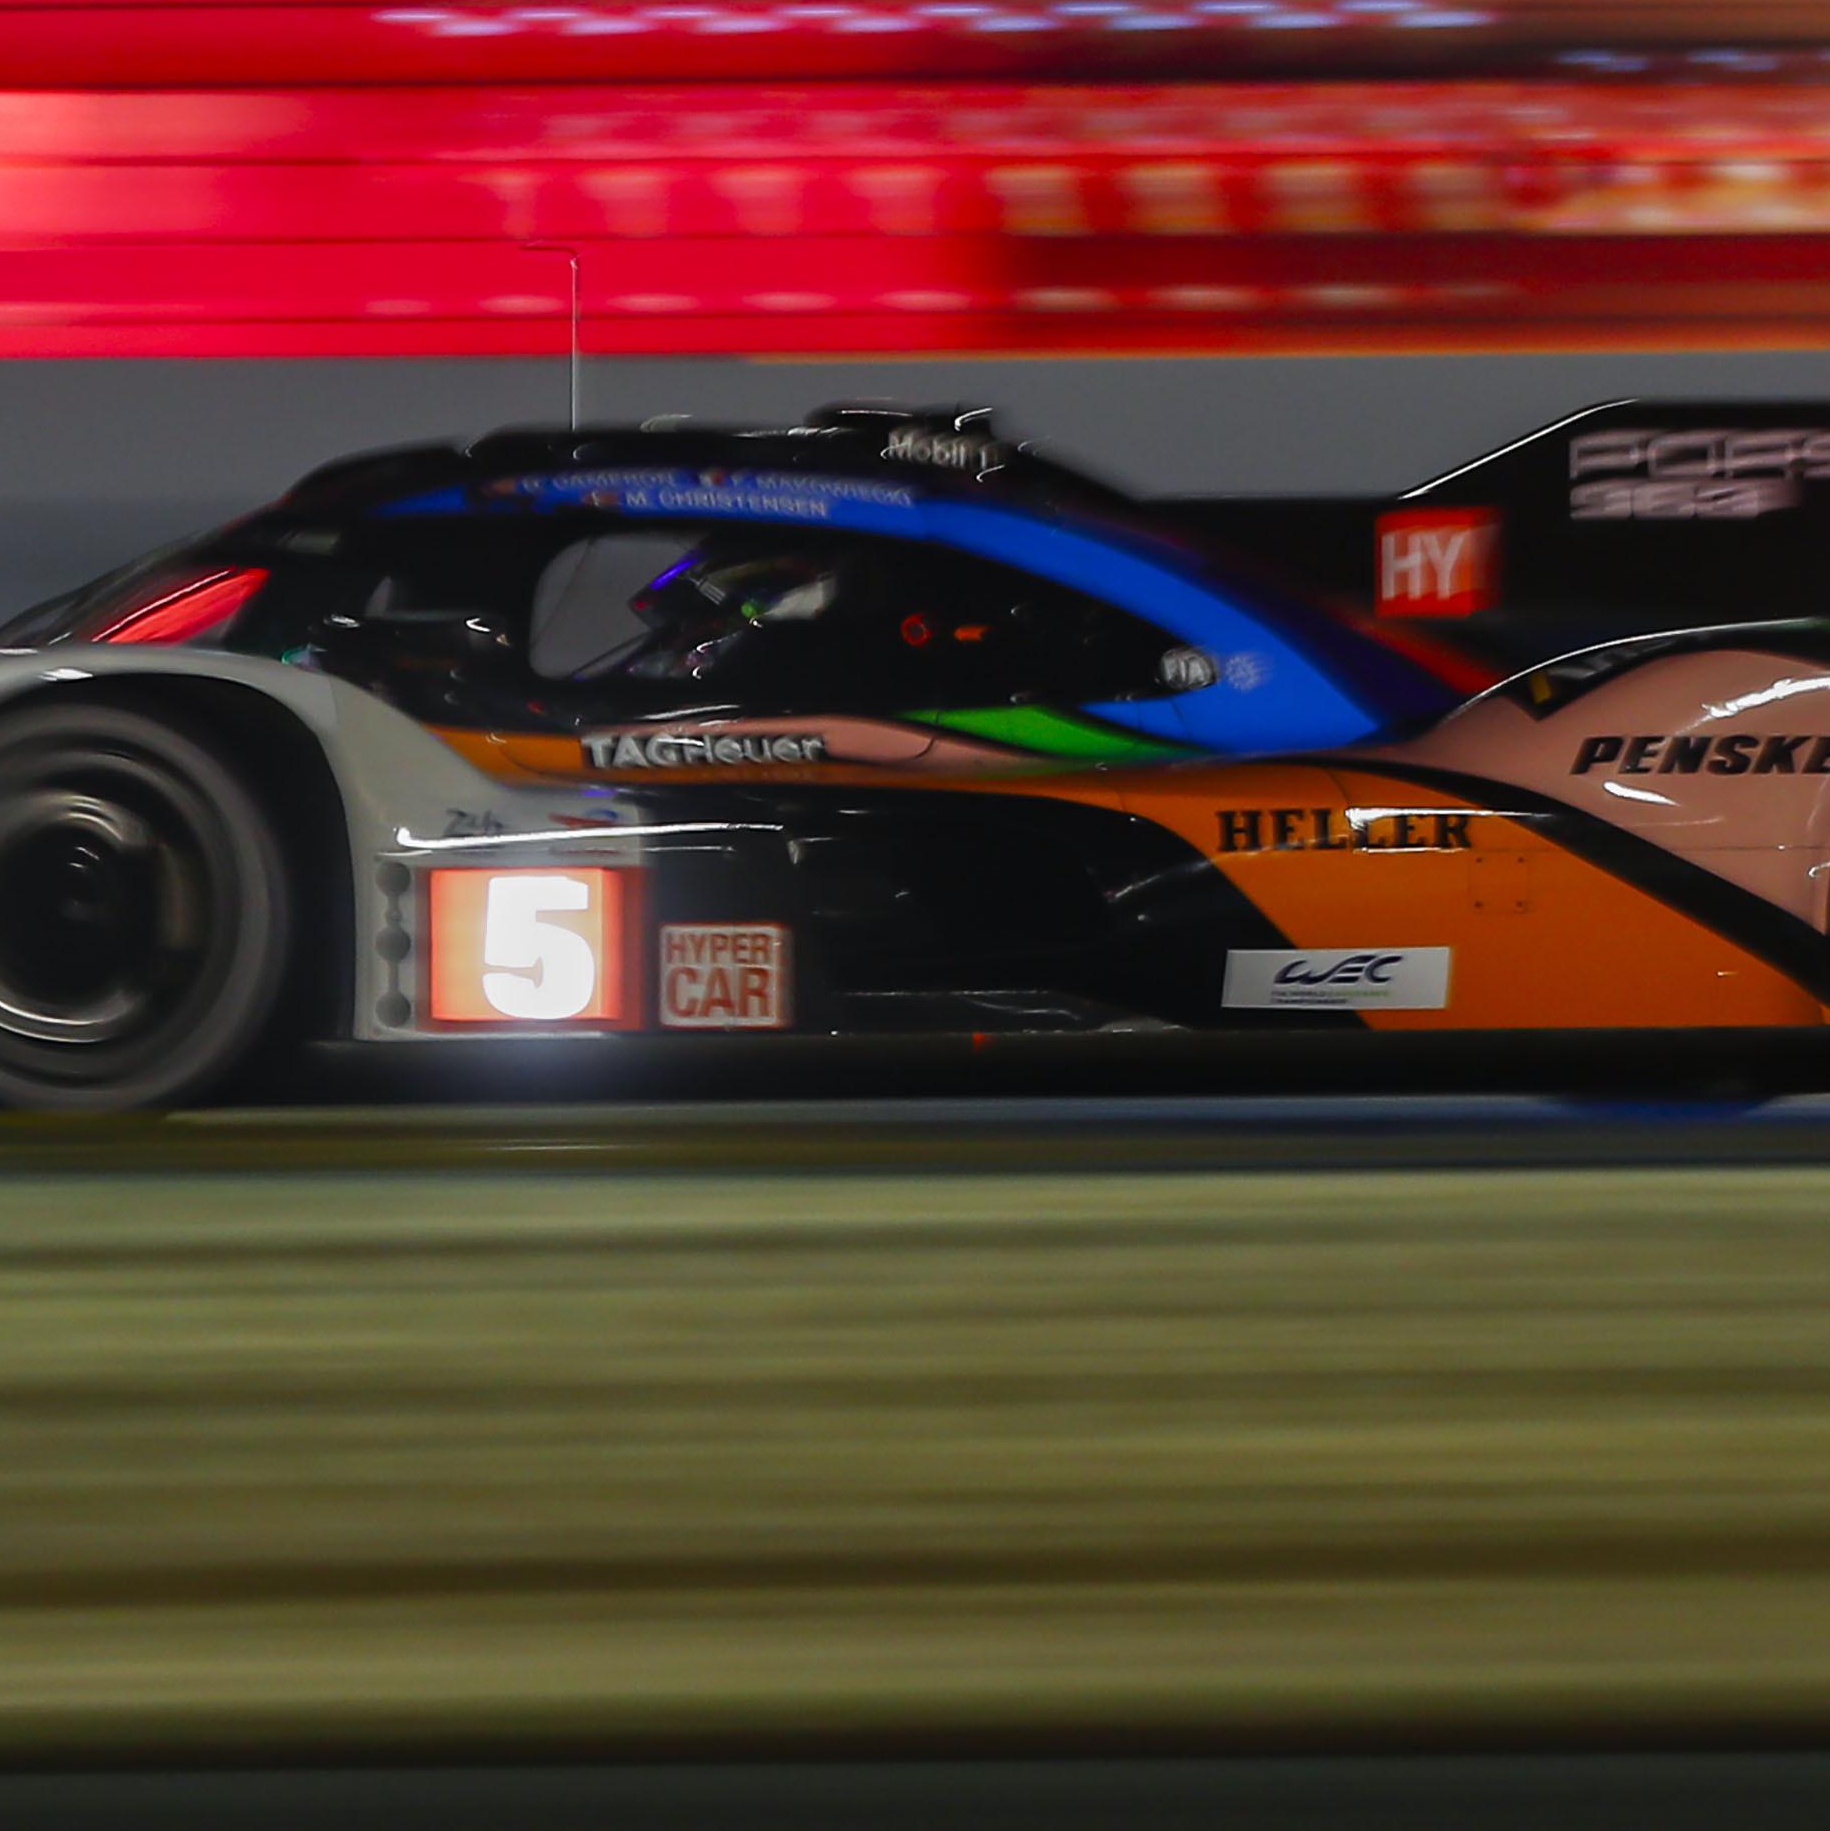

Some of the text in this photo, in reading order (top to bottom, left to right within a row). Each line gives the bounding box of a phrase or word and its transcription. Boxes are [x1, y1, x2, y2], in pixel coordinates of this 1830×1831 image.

[888, 431, 966, 468] Mobil
[658, 489, 829, 518] CHRISTENSEN
[1570, 478, 1763, 518] 963
[1381, 531, 1467, 600] HY
[1215, 809, 1472, 851] HELLER
[482, 876, 596, 1020] 5
[666, 933, 770, 964] HYPER
[1273, 954, 1404, 985] WEC
[667, 968, 769, 1018] CAR
